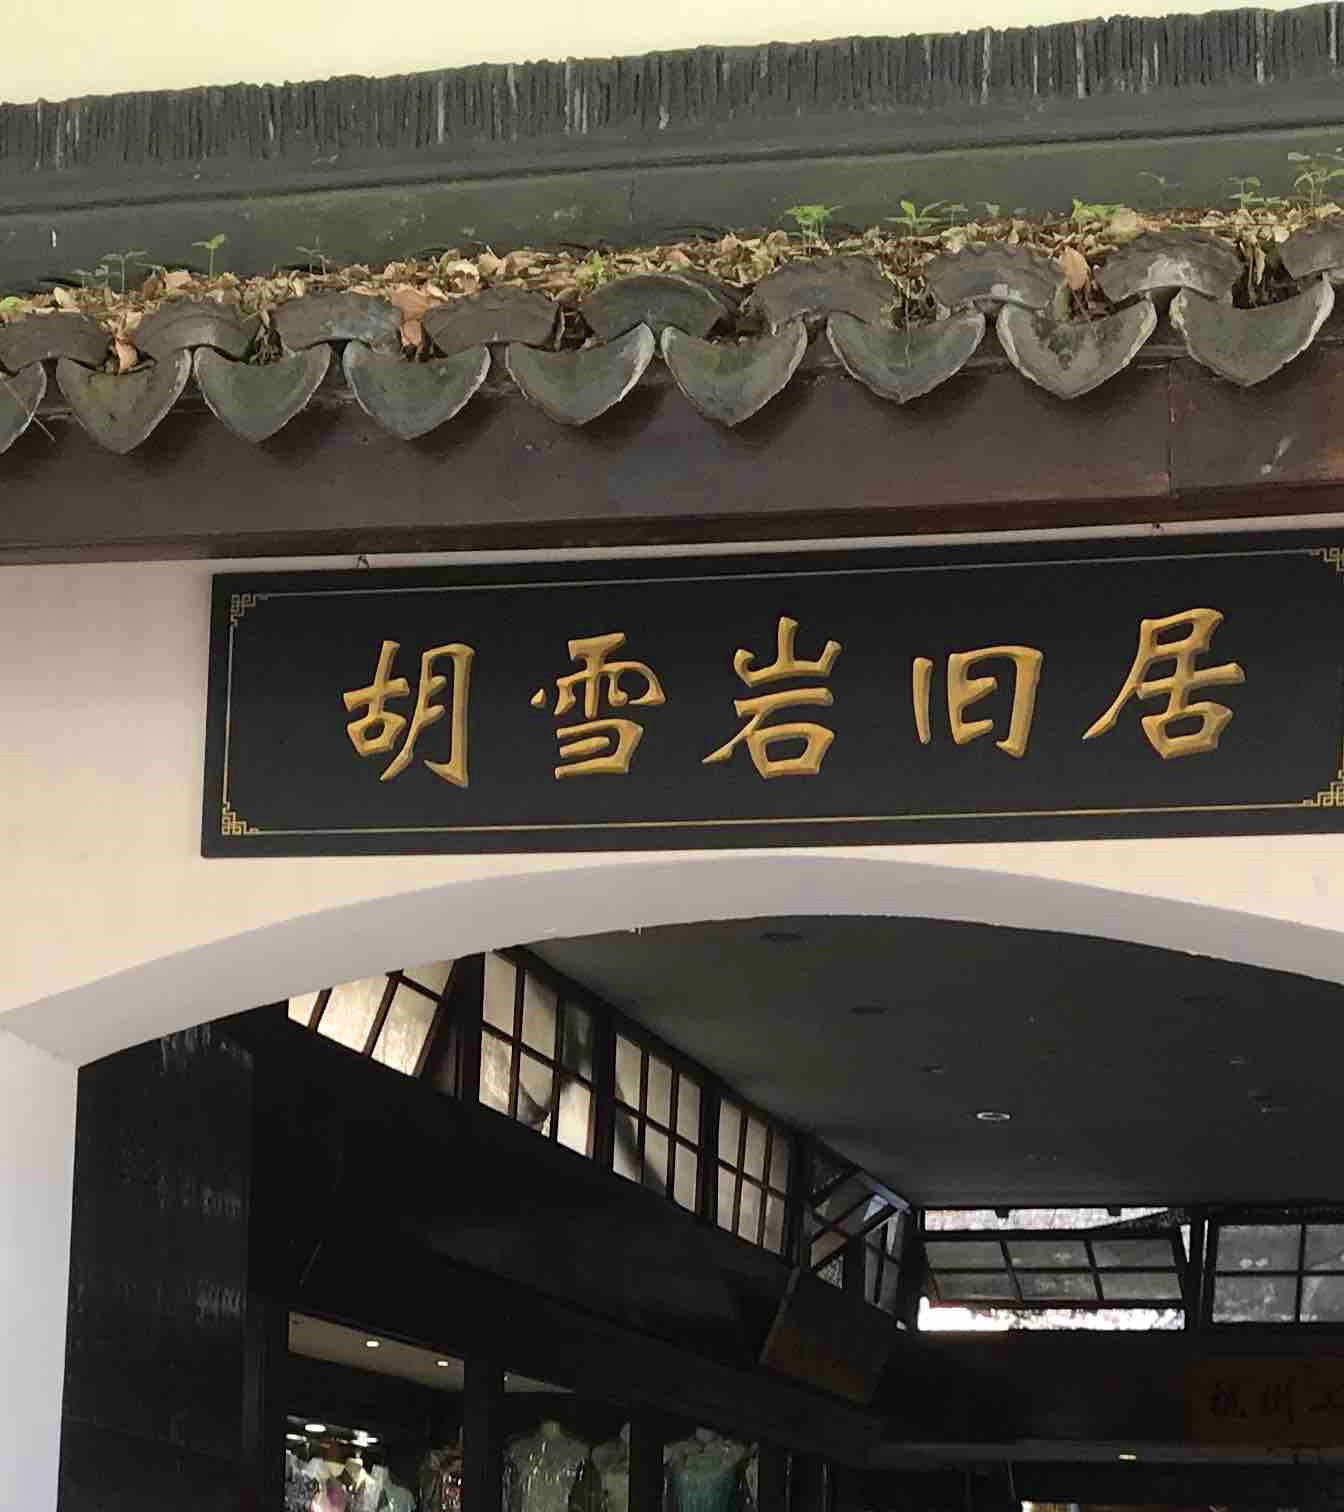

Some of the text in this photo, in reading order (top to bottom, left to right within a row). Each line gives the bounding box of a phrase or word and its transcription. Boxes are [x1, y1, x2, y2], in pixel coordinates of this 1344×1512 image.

[342, 607, 1245, 788] 胡雪岩旧居
